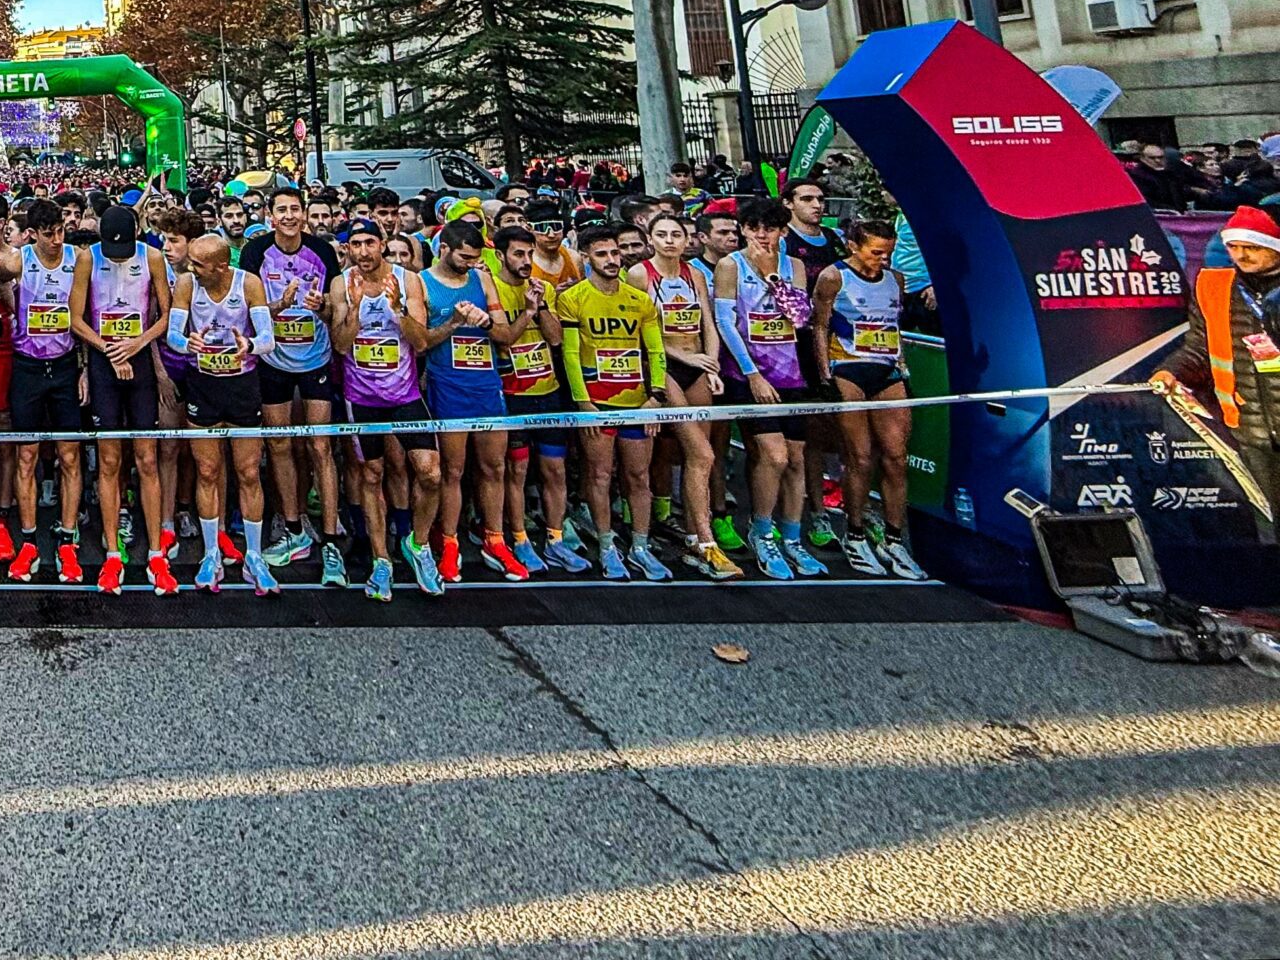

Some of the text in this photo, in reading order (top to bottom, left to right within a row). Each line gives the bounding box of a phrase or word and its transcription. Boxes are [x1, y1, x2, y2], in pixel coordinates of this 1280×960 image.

[952, 115, 1064, 134] SOLISS
[1081, 248, 1128, 271] SAN
[1035, 271, 1180, 296] SILVESTRE 20
[1162, 283, 1182, 294] 25
[40, 314, 58, 324] 175
[675, 311, 693, 321] 357
[112, 321, 130, 331] 132
[284, 323, 303, 332] 317
[588, 318, 638, 335] UPV
[762, 321, 784, 331] 299
[874, 332, 885, 342] 11
[370, 347, 384, 357] 14
[465, 346, 484, 356] 256
[210, 355, 230, 365] 410
[525, 352, 543, 363] 148
[610, 358, 630, 368] 251
[906, 454, 936, 473] RTES
